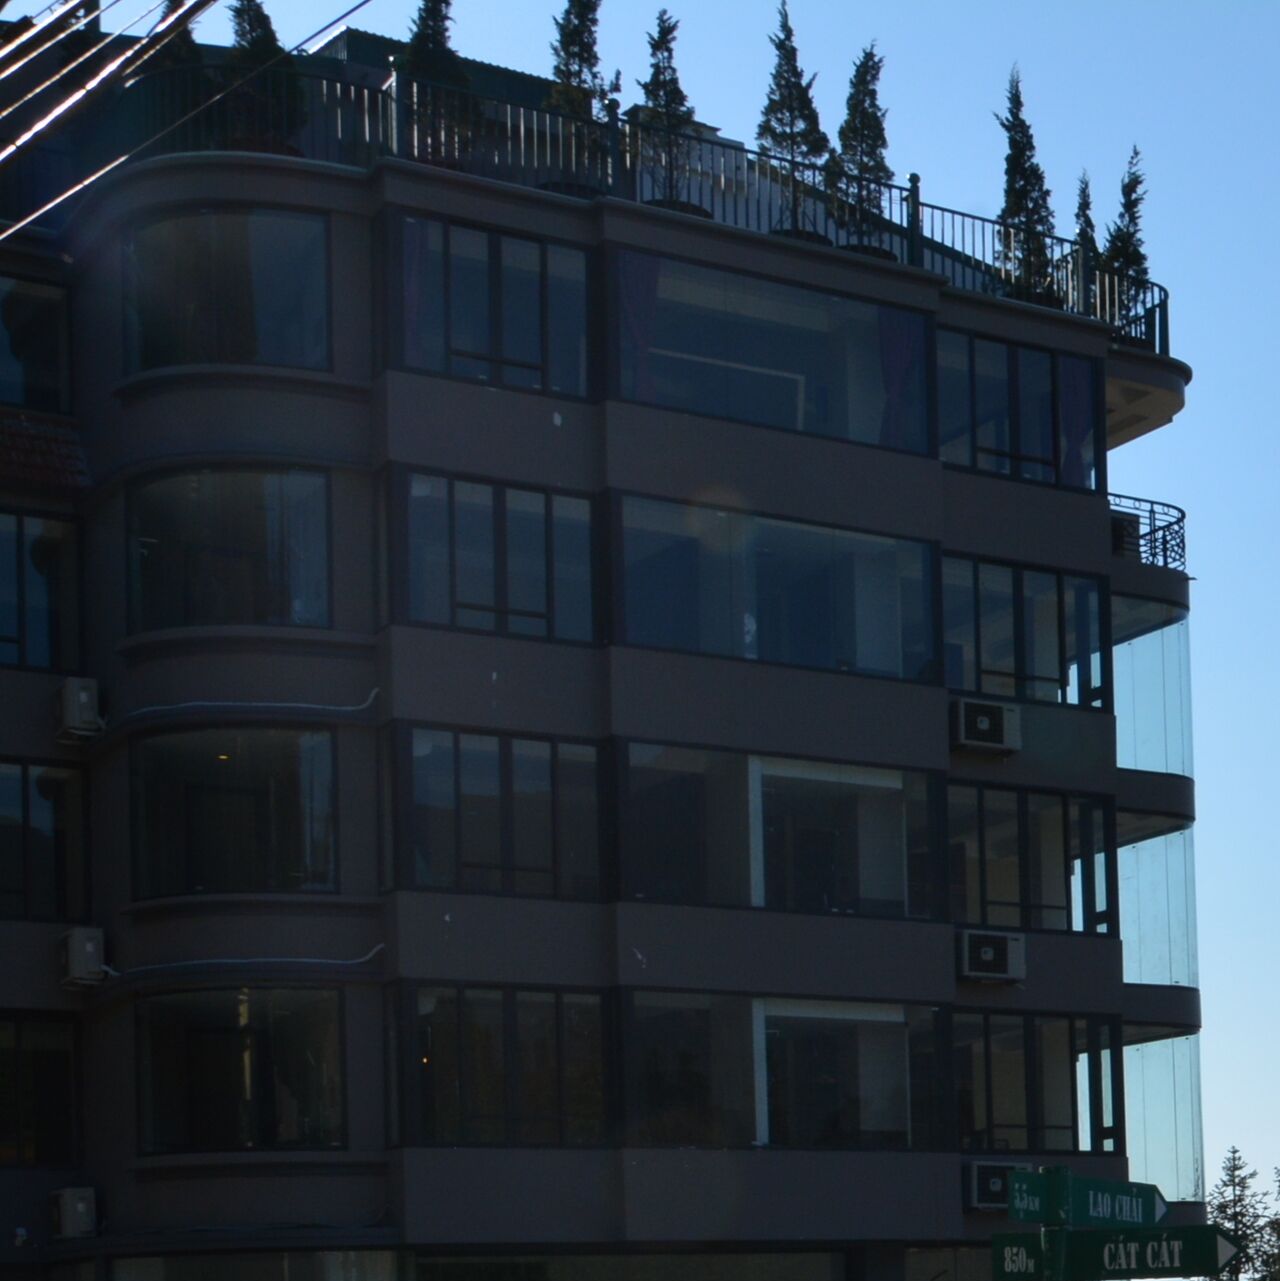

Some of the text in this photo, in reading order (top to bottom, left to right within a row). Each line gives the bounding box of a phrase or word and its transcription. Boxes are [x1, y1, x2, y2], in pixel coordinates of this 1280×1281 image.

[1088, 1190, 1111, 1218] LAO
[1103, 1233, 1183, 1270] CÁT CÁT
